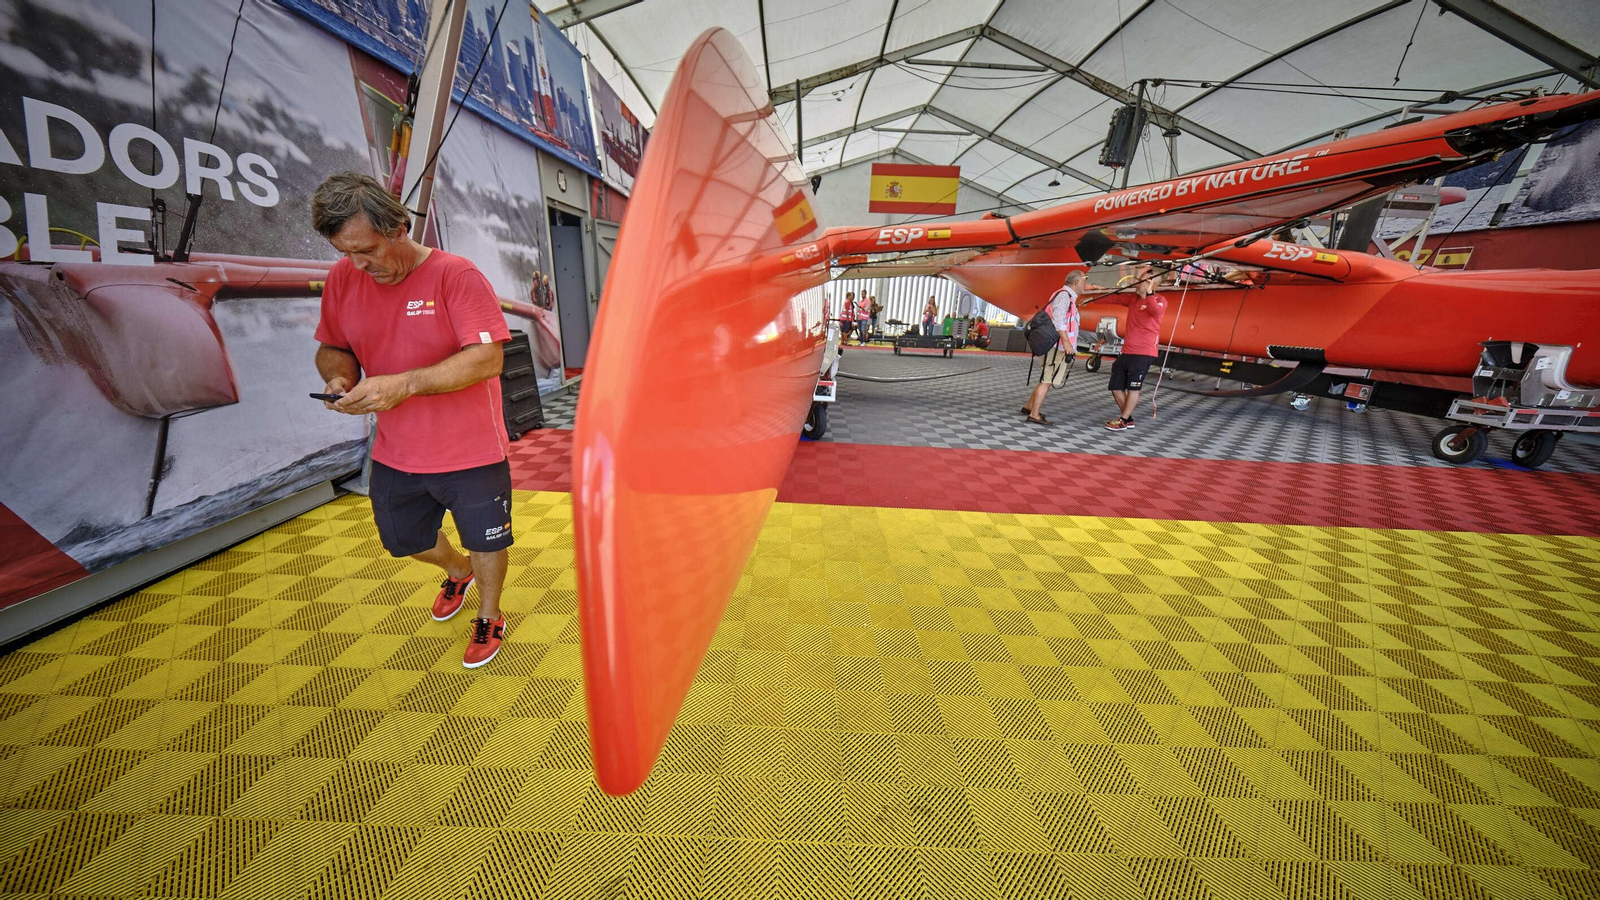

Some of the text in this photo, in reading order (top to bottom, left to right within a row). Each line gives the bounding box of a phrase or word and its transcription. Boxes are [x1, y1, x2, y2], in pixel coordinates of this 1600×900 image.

[1094, 184, 1175, 213] POWERED
[1175, 176, 1207, 197] BY
[1204, 153, 1310, 191] NATURE.
[876, 227, 924, 245] ESP
[1262, 242, 1313, 262] ESP
[406, 300, 423, 309] ESP
[485, 526, 502, 535] ESP
